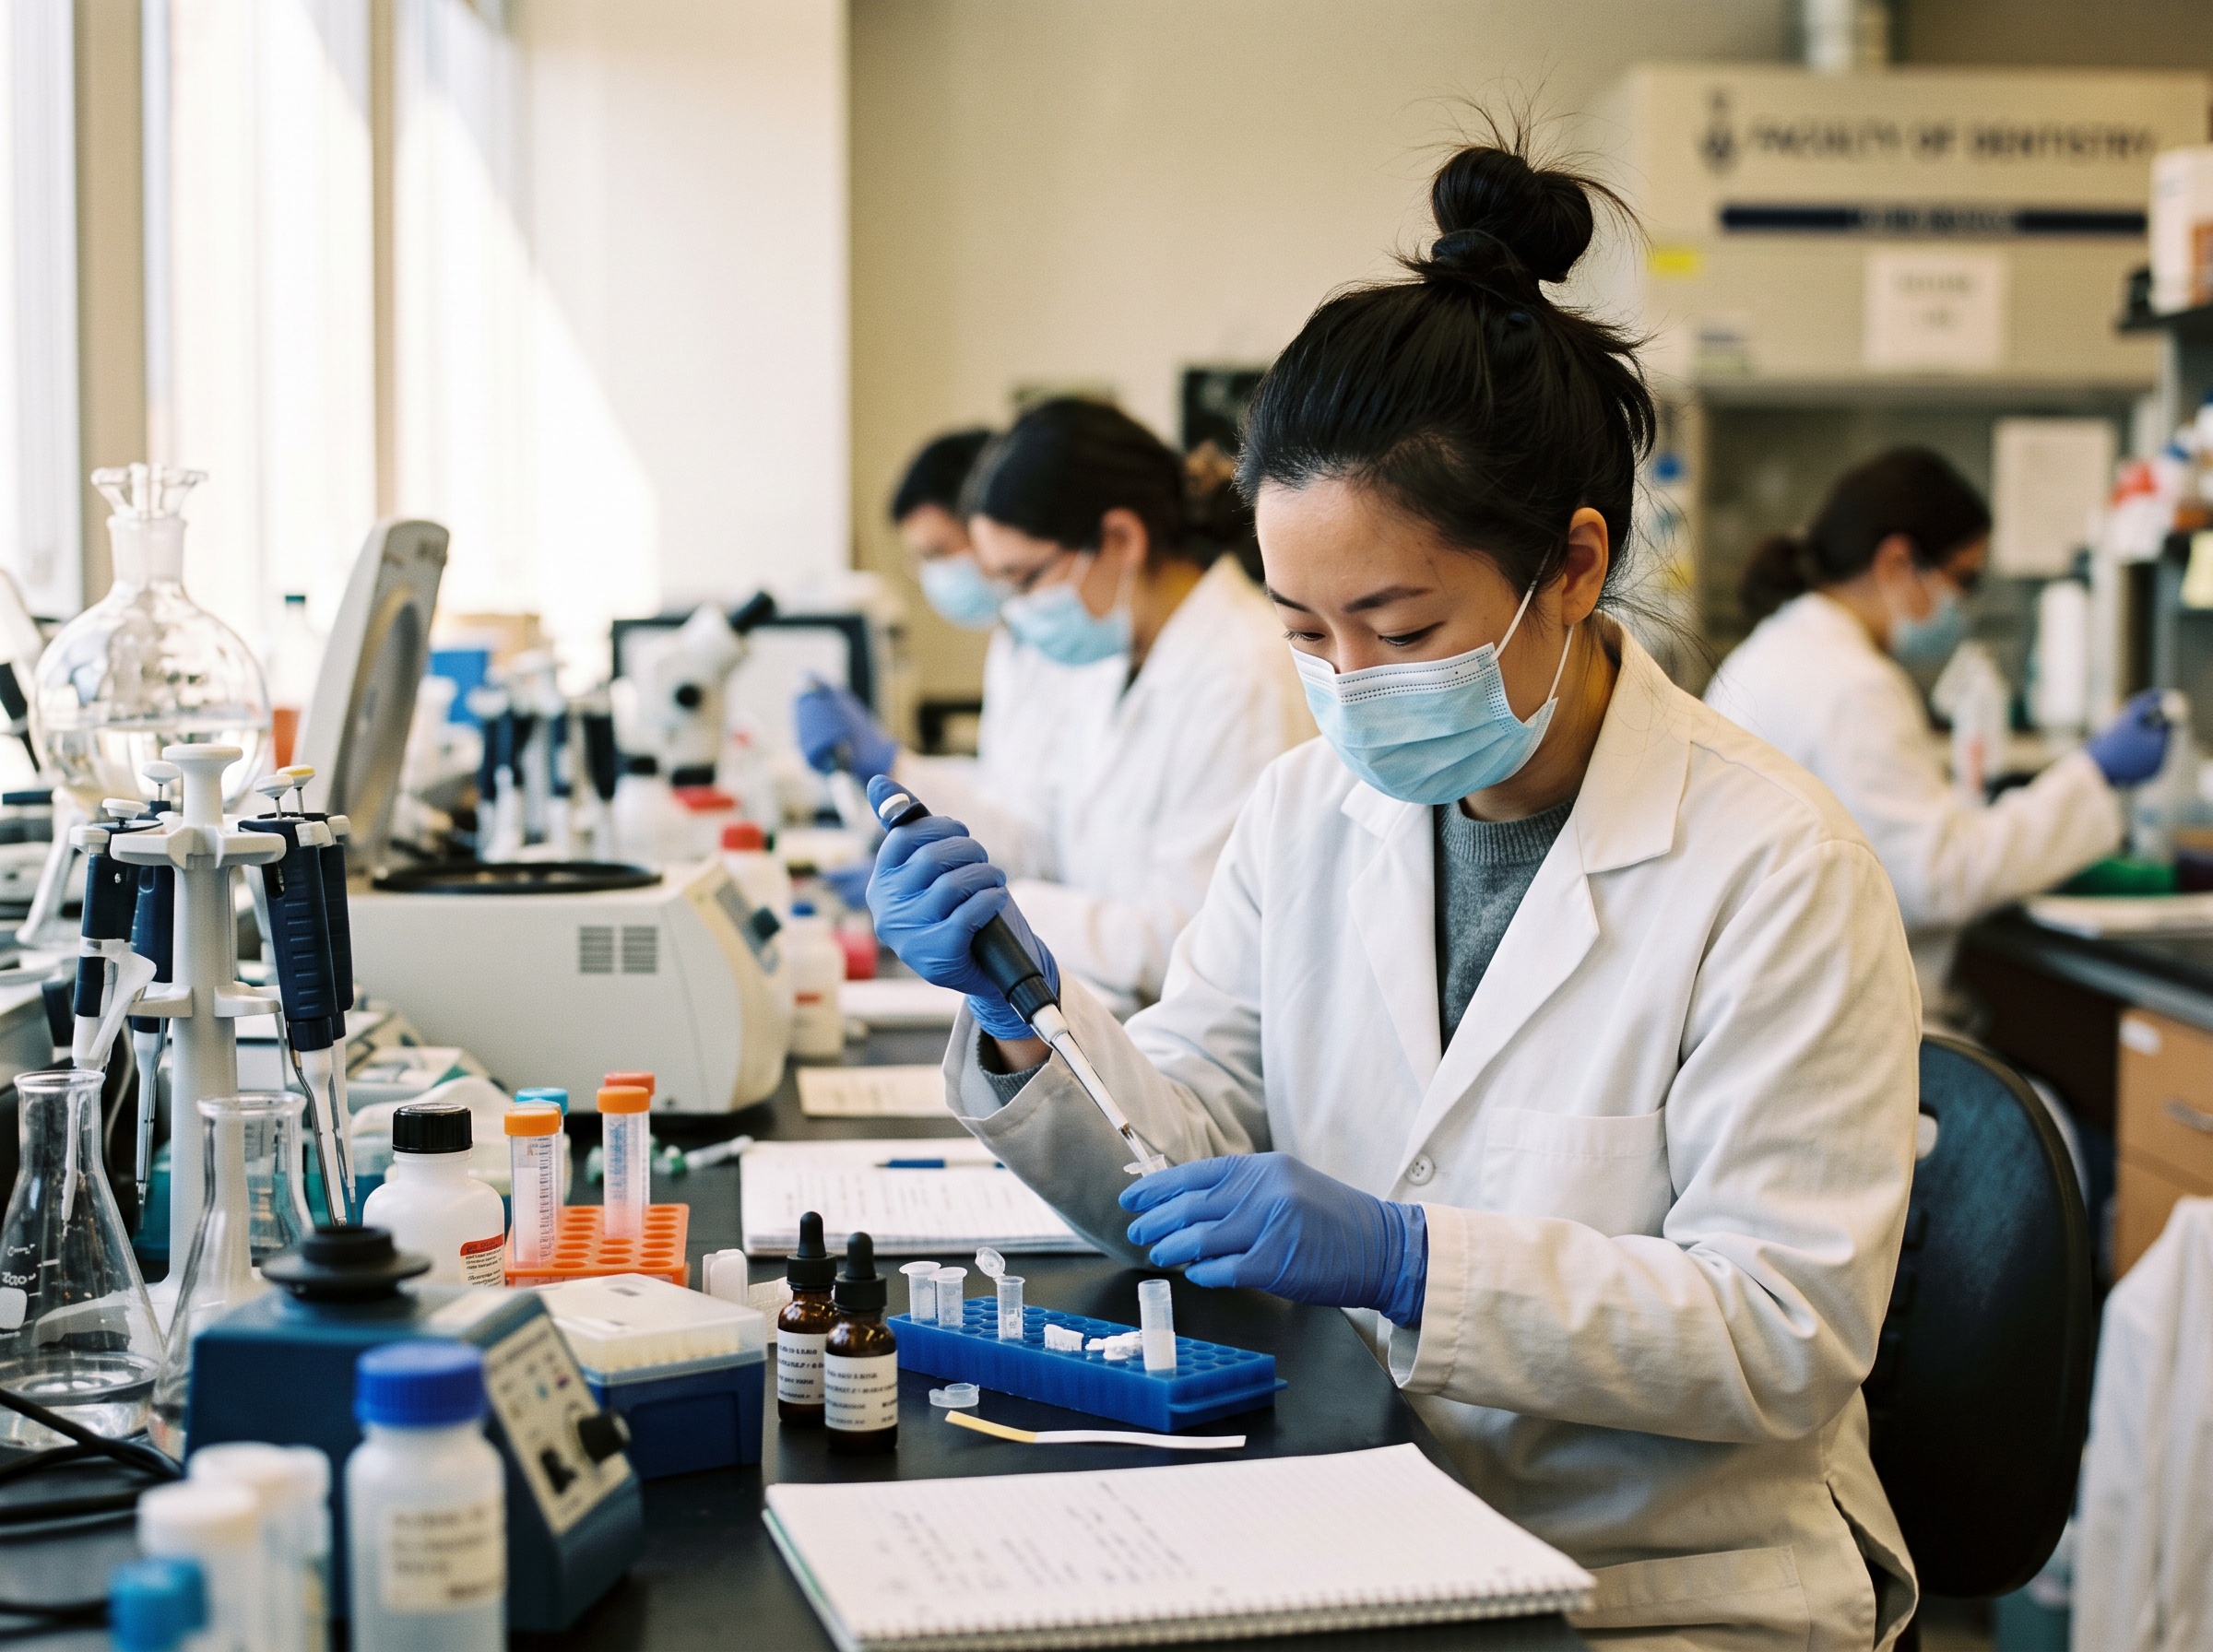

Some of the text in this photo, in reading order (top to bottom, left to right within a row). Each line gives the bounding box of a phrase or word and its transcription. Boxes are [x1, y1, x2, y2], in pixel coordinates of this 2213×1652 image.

[1750, 120, 2154, 160] FACULTY OF DENTISTRY
